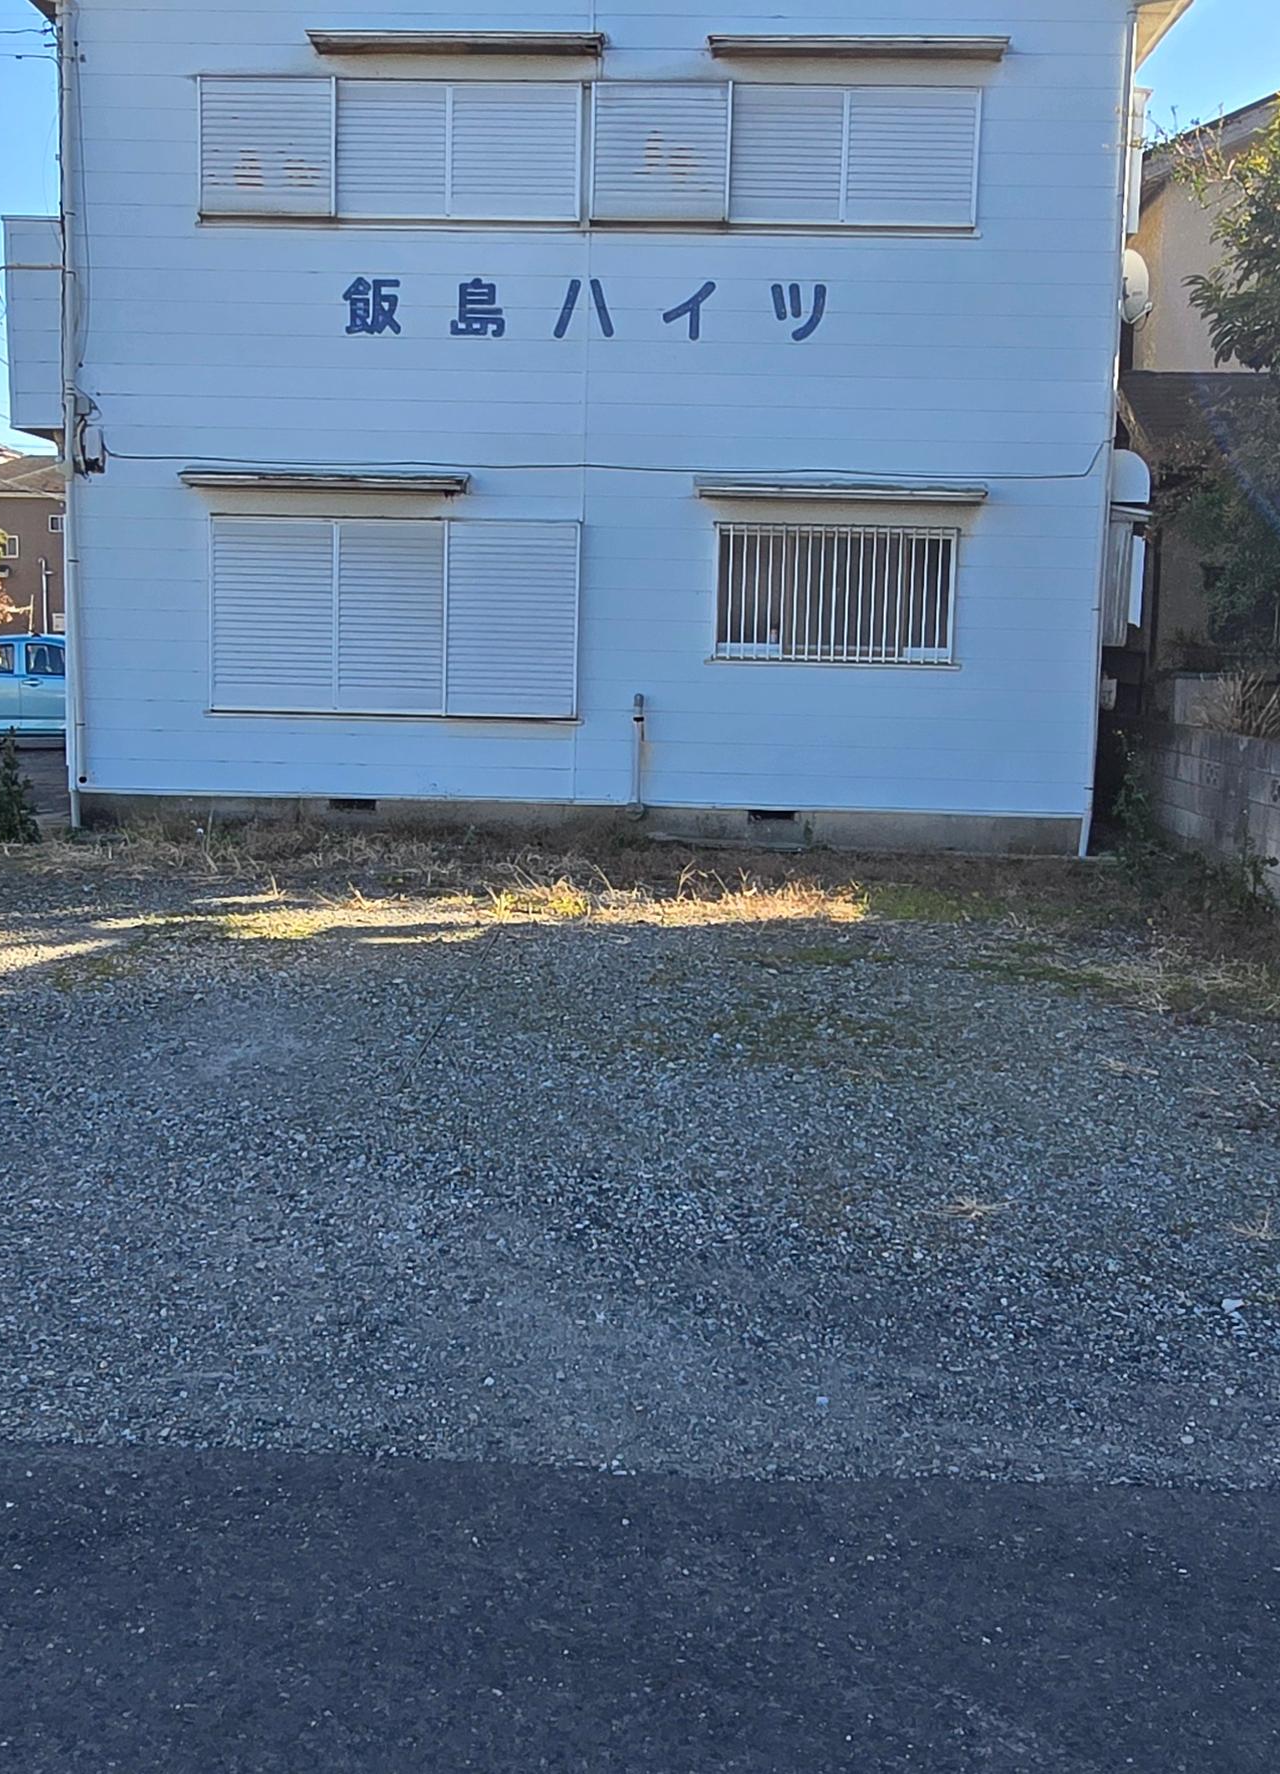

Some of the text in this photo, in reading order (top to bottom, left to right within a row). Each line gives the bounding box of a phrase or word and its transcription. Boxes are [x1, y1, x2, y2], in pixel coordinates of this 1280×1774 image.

[341, 276, 828, 342] 飯島ハイツ
